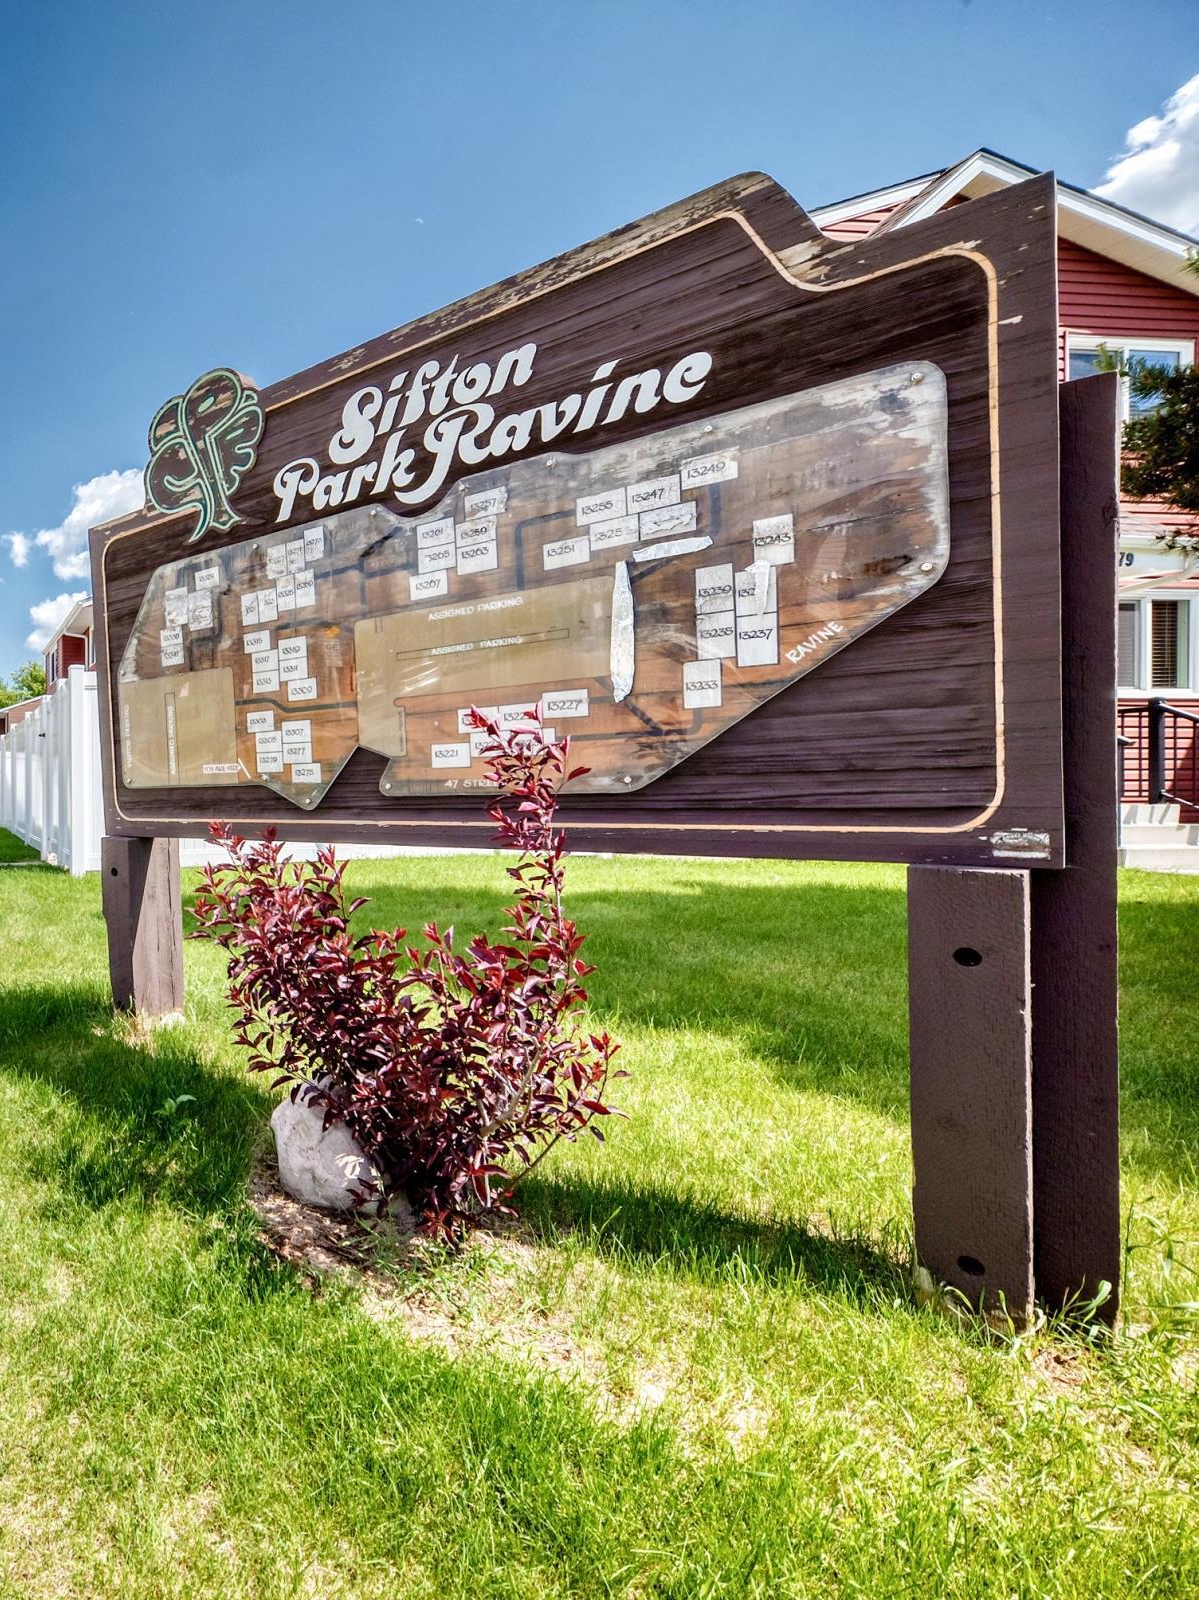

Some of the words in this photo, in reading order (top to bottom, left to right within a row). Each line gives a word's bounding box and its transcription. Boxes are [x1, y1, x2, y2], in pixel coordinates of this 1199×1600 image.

[328, 342, 538, 465] Sifton
[273, 430, 417, 524] Park
[393, 351, 713, 505] Ravine
[686, 461, 727, 479] 13249
[631, 488, 666, 504] 13247
[581, 501, 614, 516] 13255
[753, 532, 792, 548] 13243
[461, 546, 489, 559] 13263
[546, 544, 575, 558] 13251
[428, 606, 475, 621] ASSIGNED
[477, 596, 523, 612] PARKING
[738, 628, 773, 640] 13237
[431, 642, 474, 656] ASSIGNED
[480, 635, 523, 648] PARKING
[785, 620, 844, 664] RAVINE
[685, 679, 719, 692] 13233
[546, 699, 583, 711] 13227
[503, 711, 528, 722] 1322
[434, 749, 459, 759] 13221
[444, 779, 459, 788] 47
[463, 779, 502, 788] STREE
